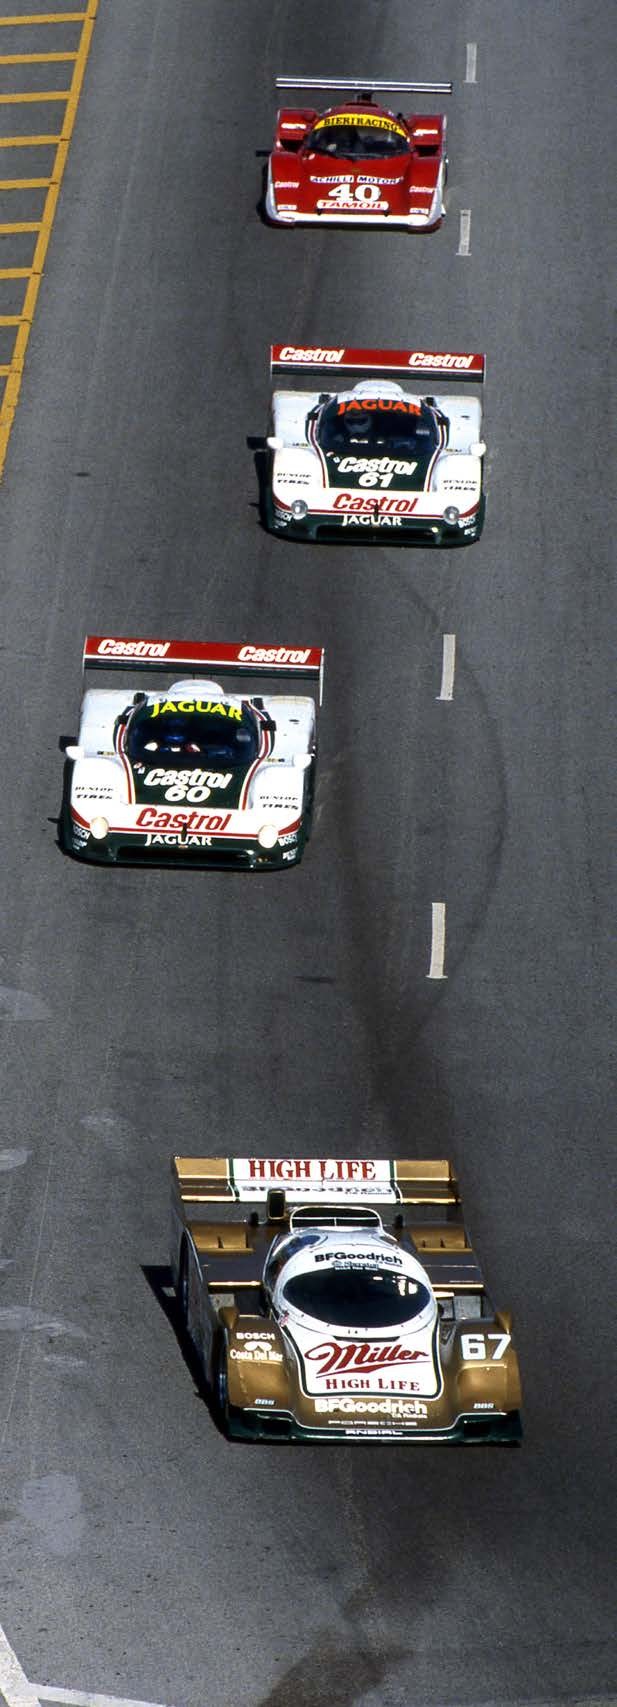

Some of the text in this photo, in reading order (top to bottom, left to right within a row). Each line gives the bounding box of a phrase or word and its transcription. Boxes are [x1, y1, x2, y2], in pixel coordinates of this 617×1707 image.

[357, 118, 399, 132] RACING
[328, 184, 381, 202] 40
[321, 201, 382, 210] TAMOIL
[279, 346, 474, 369] Castrol Castrol
[337, 399, 423, 416] JAGUAR
[338, 457, 418, 476] Castrol
[358, 472, 393, 488] 61
[333, 493, 419, 513] Castrol
[342, 514, 402, 527] JAGUAR
[97, 639, 310, 664] Castrol Castrol
[150, 700, 244, 721] JAGUAR
[143, 768, 233, 789] Castrol
[164, 785, 211, 803] 60
[135, 807, 233, 831] Castrol
[144, 833, 213, 846] JAGUAR
[248, 1160, 376, 1180] HIGH LIFE
[314, 1252, 403, 1265] BFGoodrich
[236, 1332, 276, 1340] BOSCH
[229, 1348, 253, 1360] Costa
[254, 1350, 268, 1360] Del
[460, 1333, 512, 1361] 67
[304, 1341, 429, 1375] Miller
[325, 1378, 420, 1392] HIGH LIFE
[314, 1398, 428, 1415] BFGoodrich
